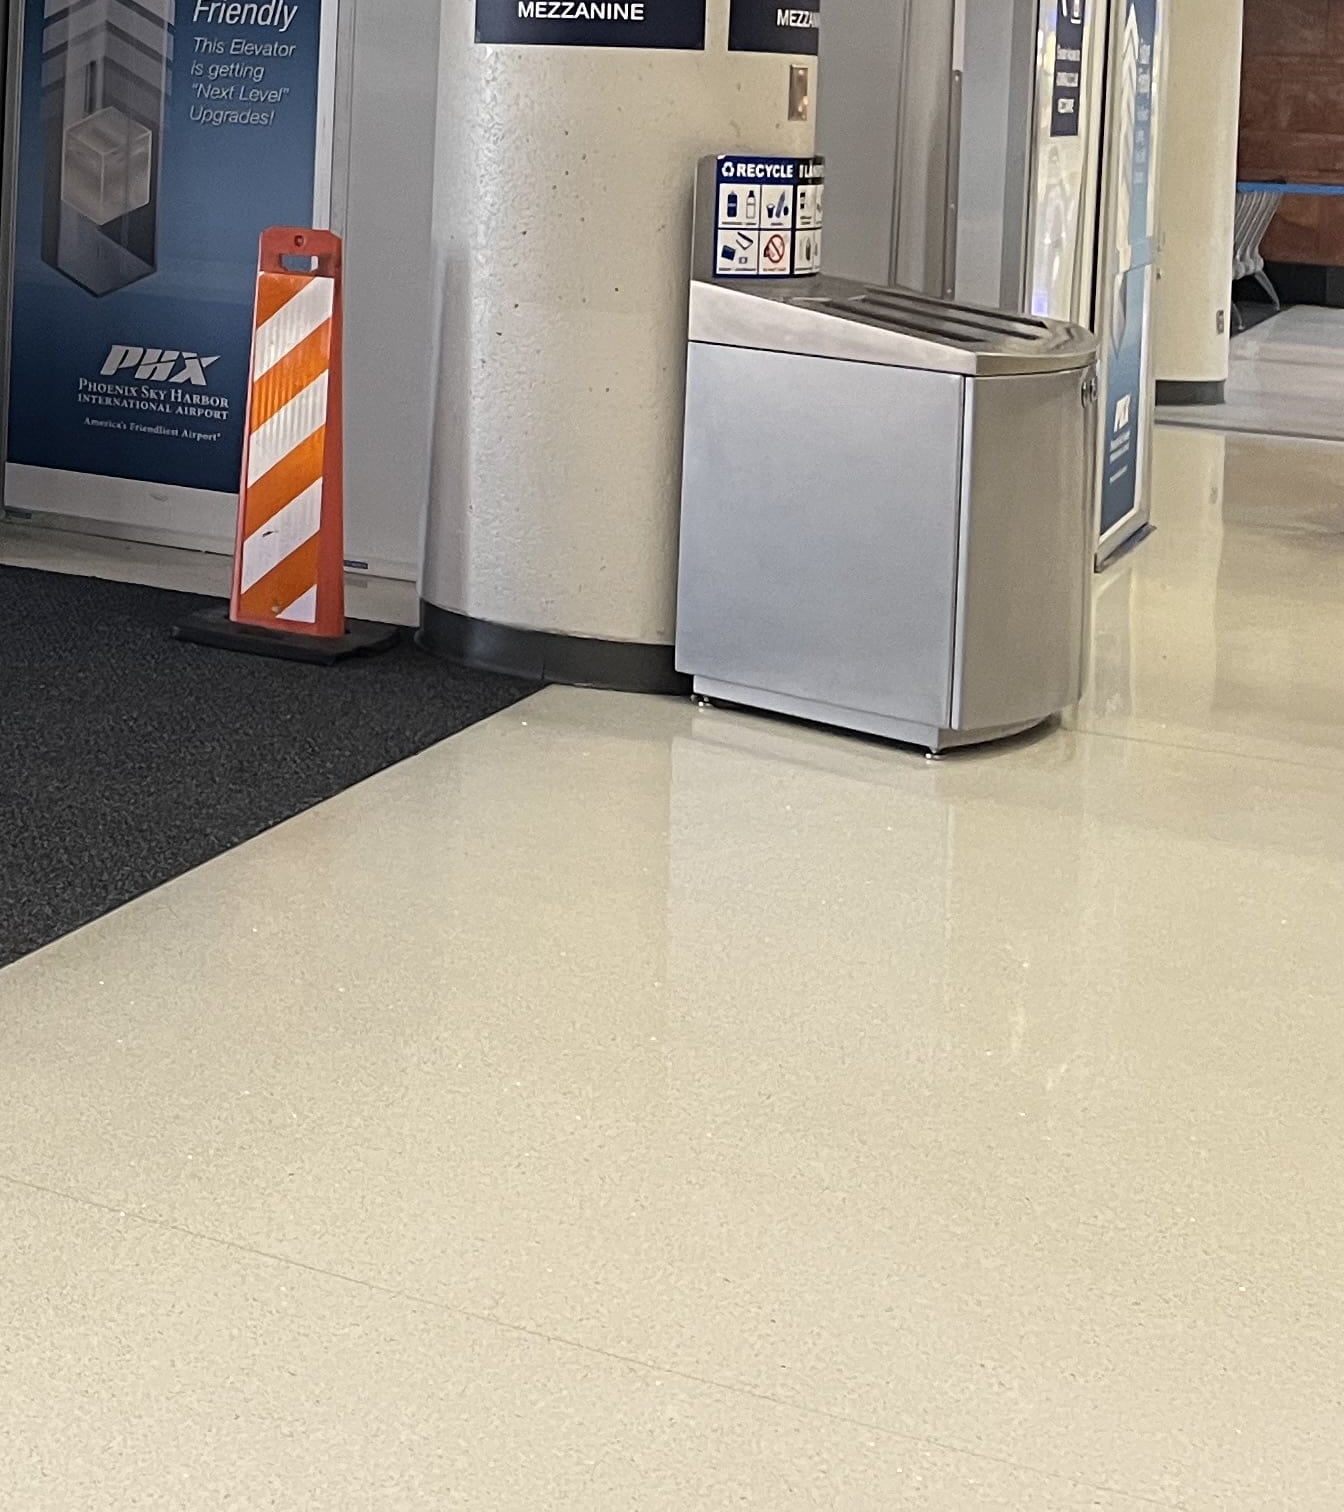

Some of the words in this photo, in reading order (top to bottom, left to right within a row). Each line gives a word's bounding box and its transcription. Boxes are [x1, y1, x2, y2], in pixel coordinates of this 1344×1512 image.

[518, 1, 644, 21] MEZZANINE
[194, 37, 225, 53] This
[229, 39, 296, 56] Elevator
[191, 60, 204, 76] is
[208, 62, 265, 82] getting
[190, 105, 275, 126] Upgrades!
[736, 163, 794, 178] RECYCLE
[100, 345, 221, 386] PHX
[79, 378, 138, 397] PHOENIX
[141, 385, 167, 400] SKY
[170, 389, 229, 409] HARBOR
[78, 393, 172, 413] INTERNATIONAL
[175, 405, 229, 420] AIRPORT
[84, 417, 127, 430] America's
[130, 422, 179, 436] Friendliest
